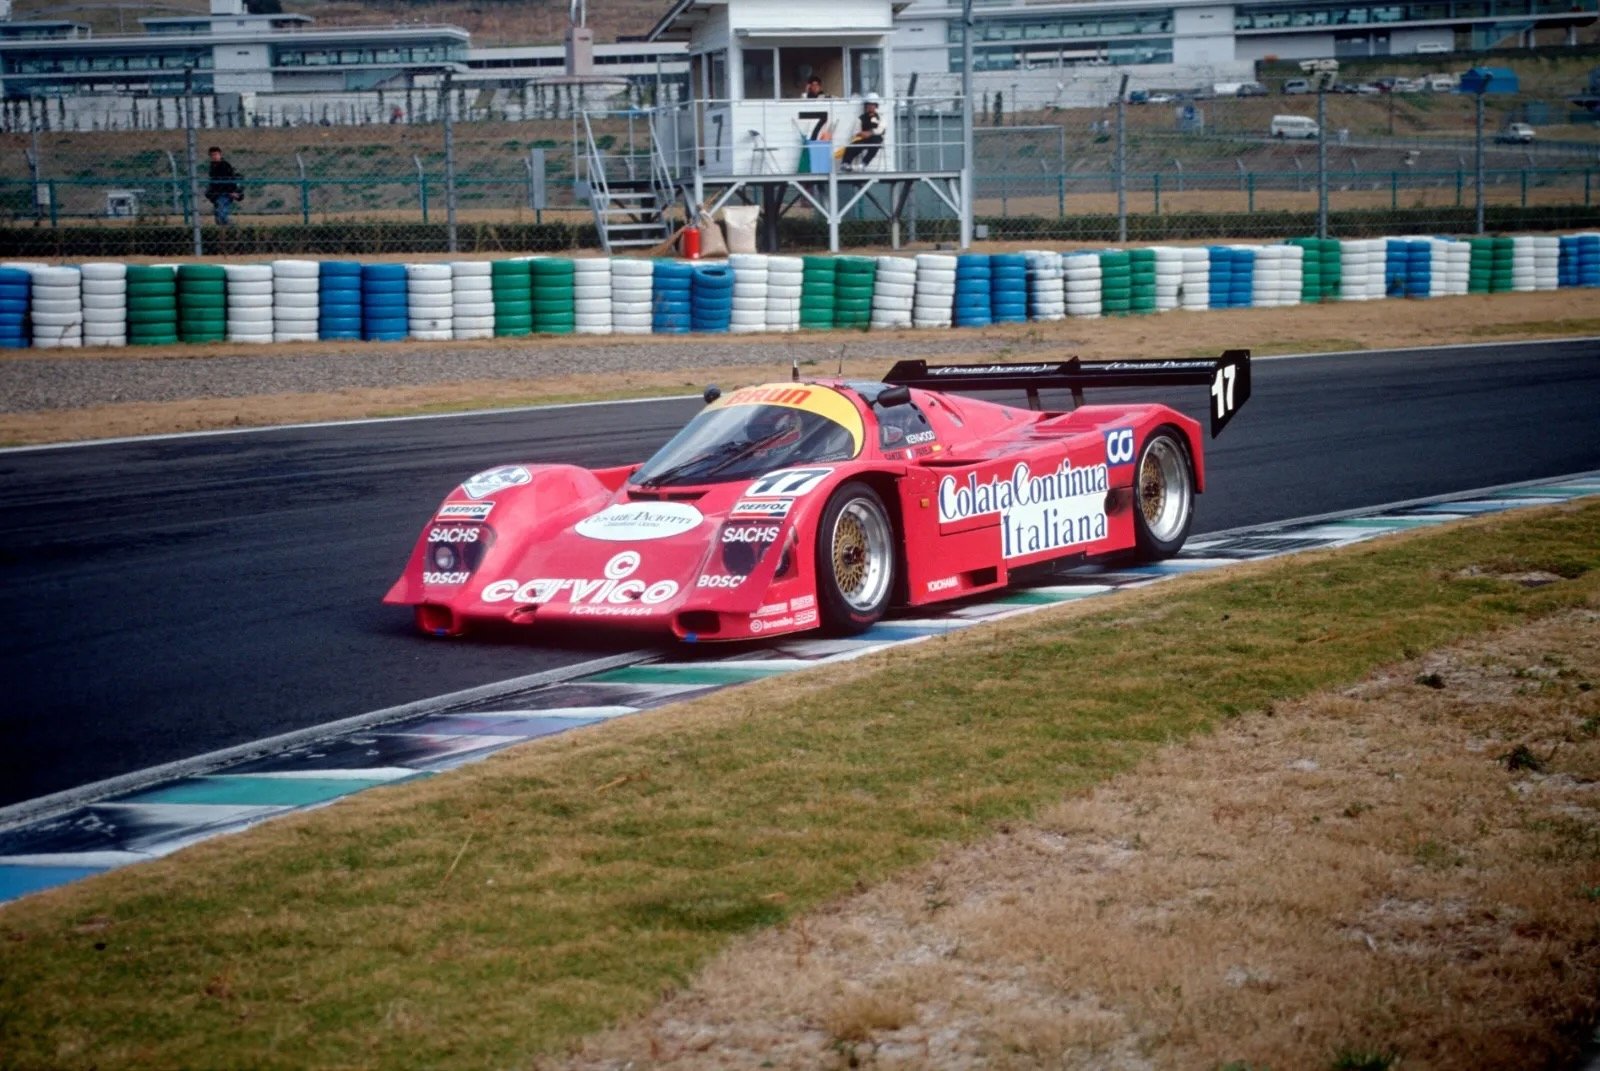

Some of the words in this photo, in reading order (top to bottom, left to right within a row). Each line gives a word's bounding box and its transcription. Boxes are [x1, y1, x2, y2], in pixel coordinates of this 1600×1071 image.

[799, 112, 828, 141] 7
[712, 114, 723, 162] 7
[1211, 364, 1236, 419] 17
[905, 430, 936, 444] KENWOOD
[752, 469, 833, 494] 17
[737, 503, 788, 511] REPSOL
[427, 527, 480, 543] SACHS
[721, 527, 780, 543] SACHS
[1002, 508, 1107, 556] Italiana
[423, 572, 470, 584] BOSCH
[569, 605, 653, 616] YOKOHAMA
